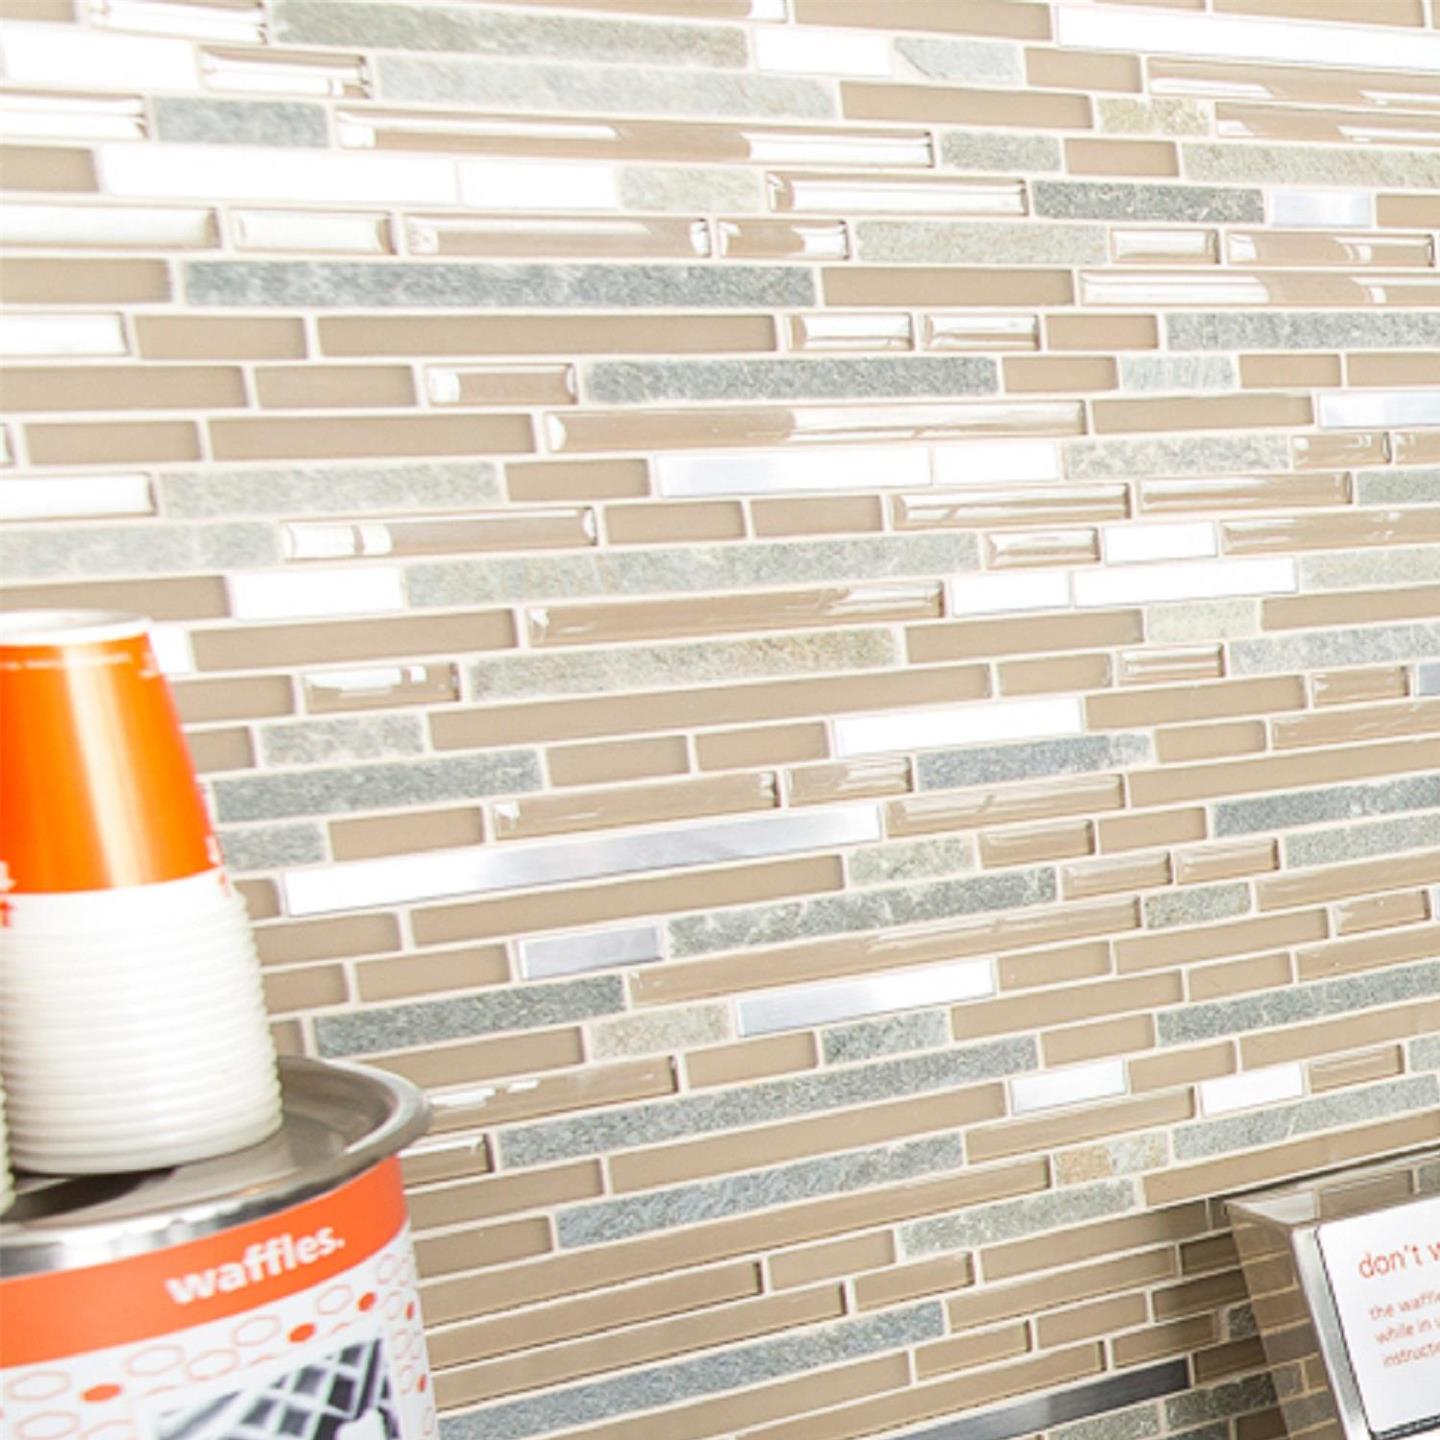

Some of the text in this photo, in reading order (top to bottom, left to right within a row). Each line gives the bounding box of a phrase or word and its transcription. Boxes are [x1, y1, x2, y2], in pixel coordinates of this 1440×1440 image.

[164, 1226, 346, 1306] waffles.
[1358, 1244, 1423, 1279] don't
[1369, 1303, 1395, 1321] the
[1376, 1323, 1414, 1345] while
[1418, 1318, 1433, 1333] in
